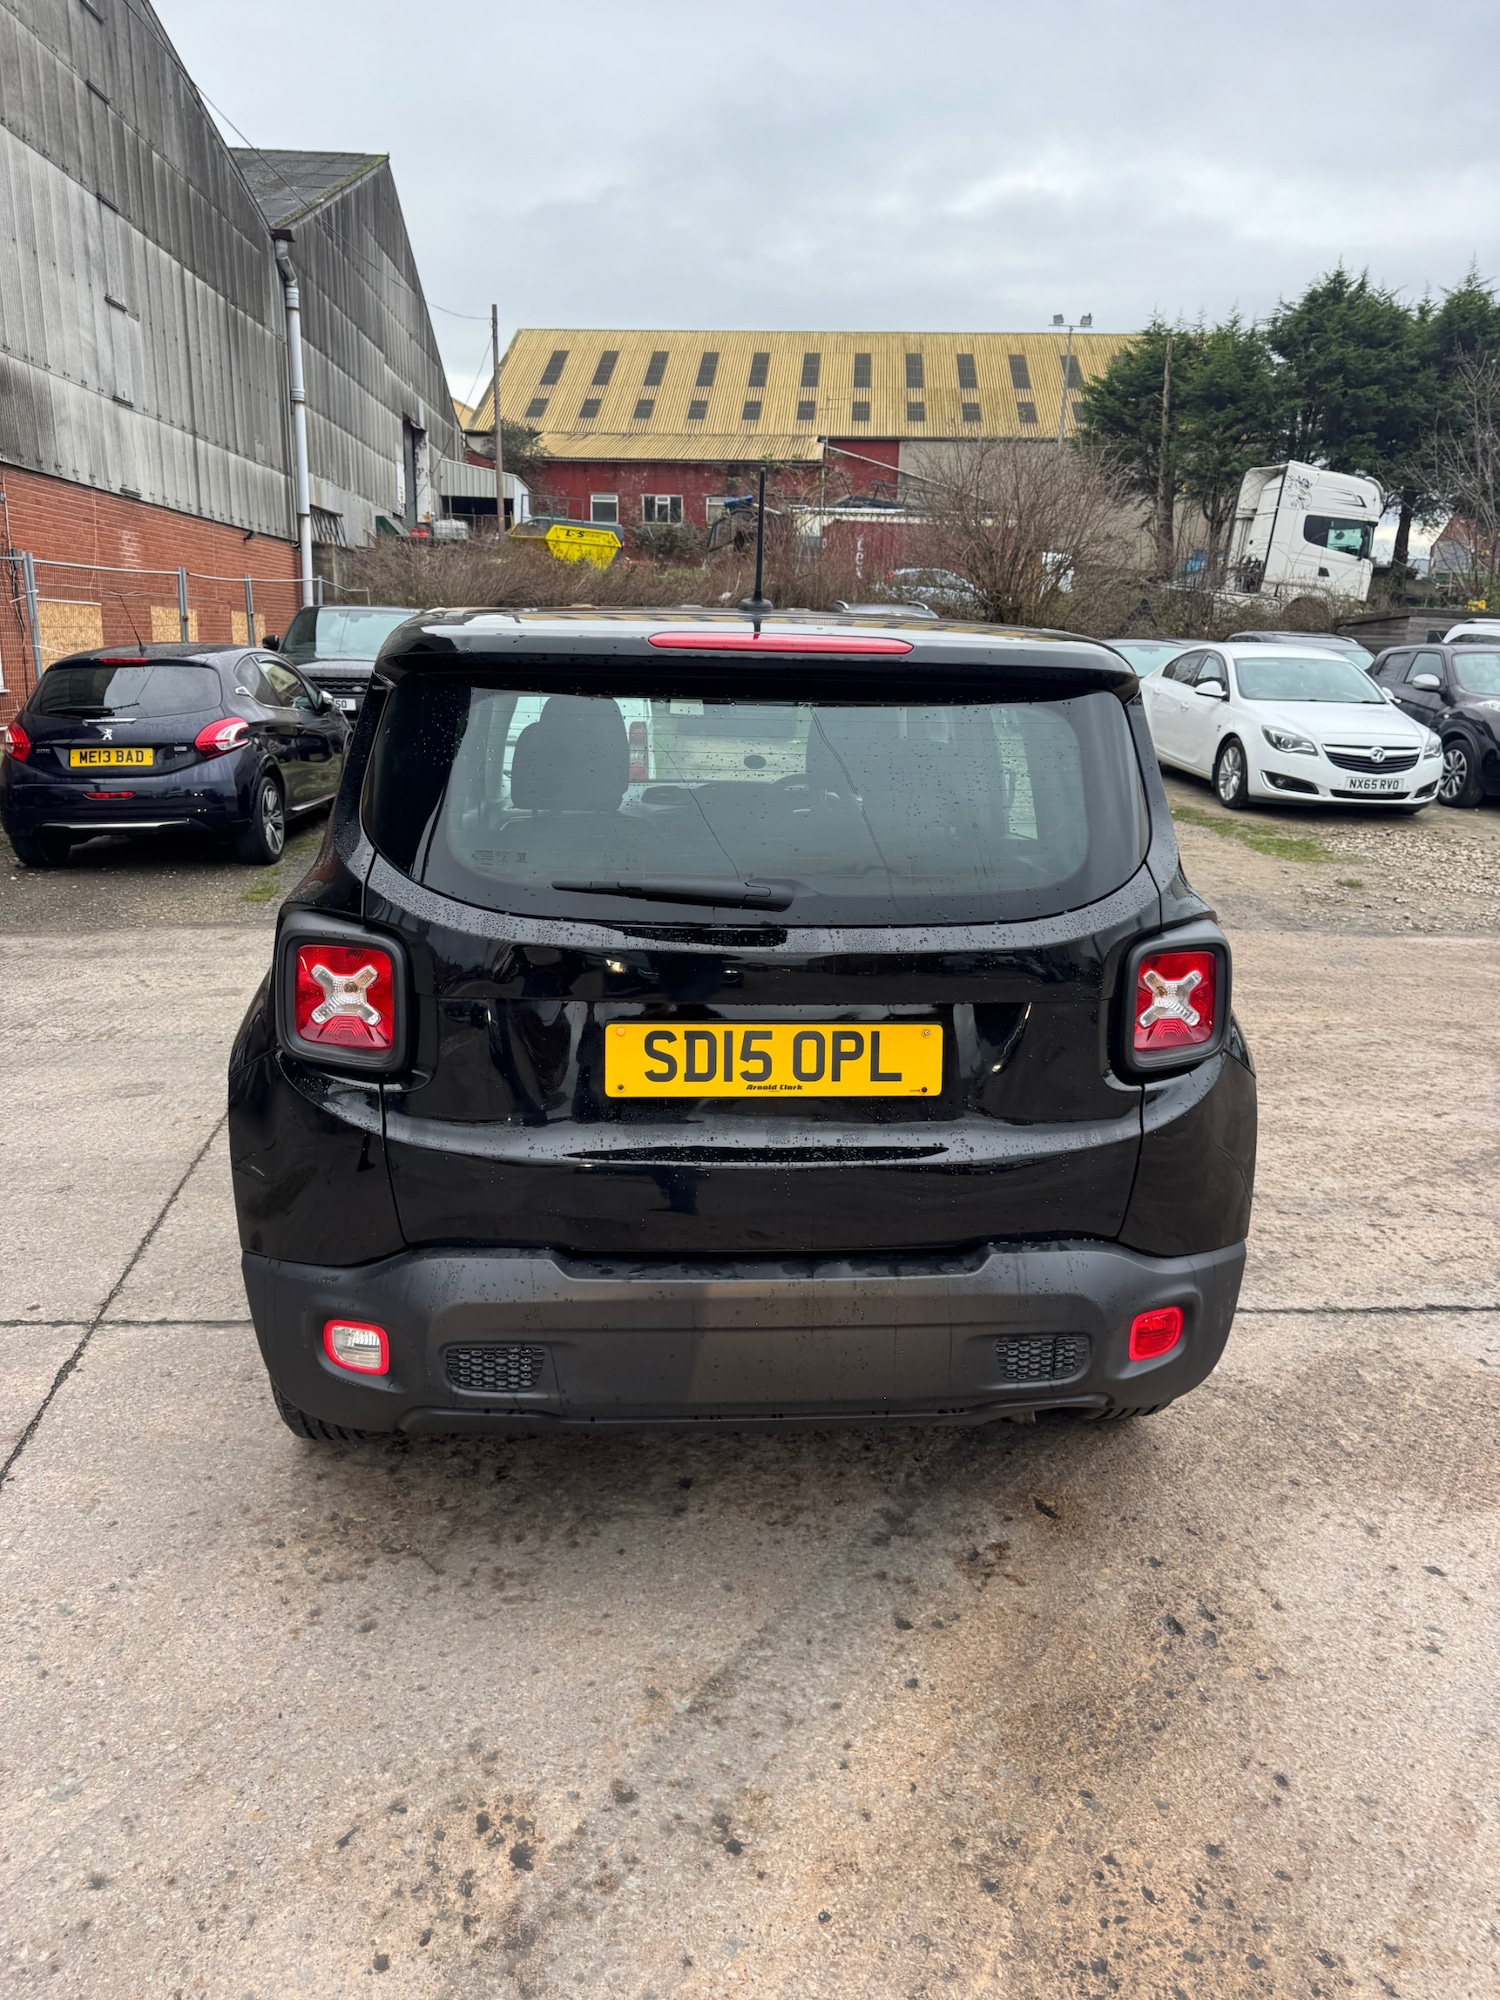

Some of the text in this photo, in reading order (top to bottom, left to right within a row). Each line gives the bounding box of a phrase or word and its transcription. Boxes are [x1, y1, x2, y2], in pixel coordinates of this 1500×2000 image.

[79, 750, 144, 764] ME13 BAD
[1349, 779, 1399, 790] NX65 RVO
[644, 1030, 903, 1083] SD15 OPL
